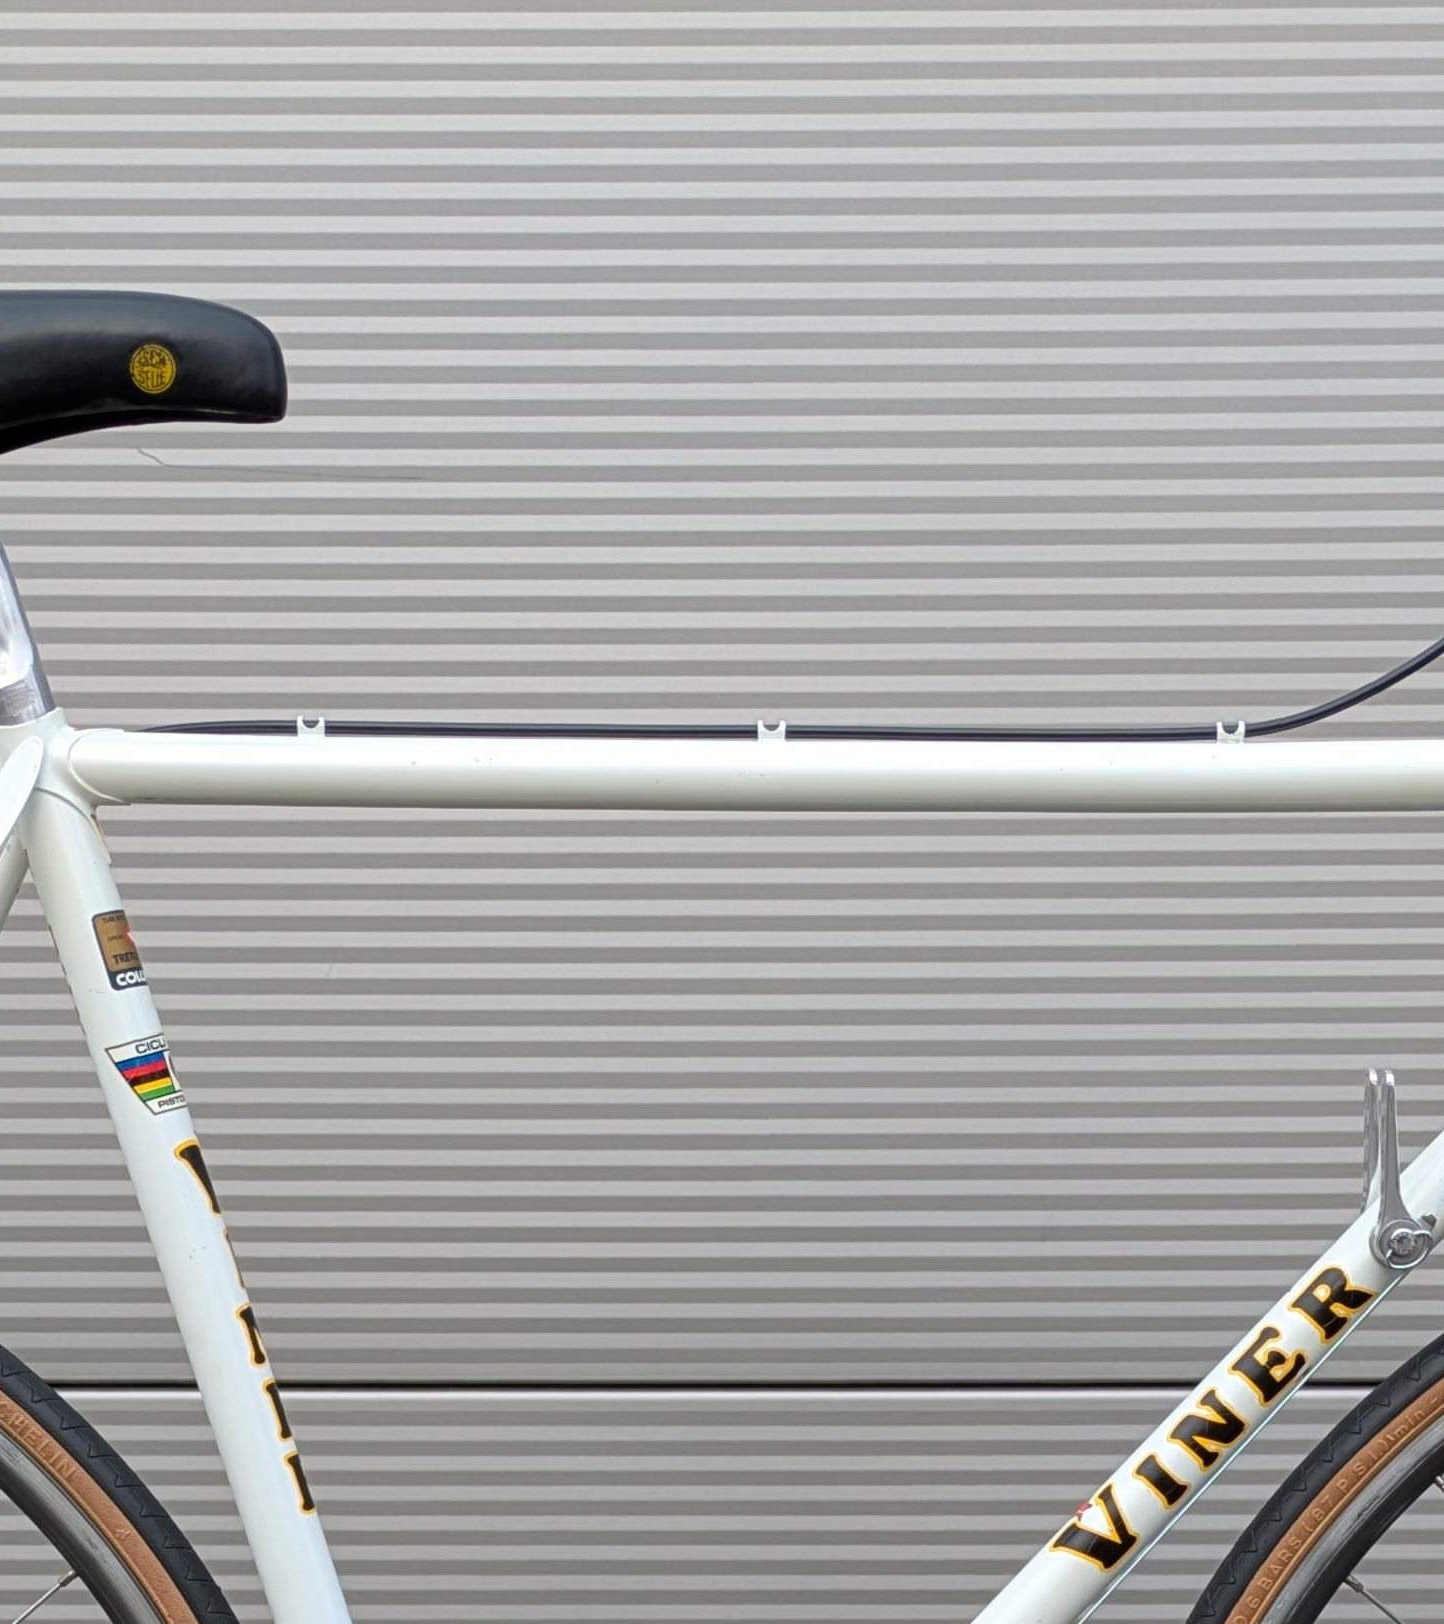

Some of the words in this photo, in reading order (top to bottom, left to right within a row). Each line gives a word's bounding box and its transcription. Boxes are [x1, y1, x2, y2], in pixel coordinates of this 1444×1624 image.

[1050, 1265, 1378, 1574] VINER
[1243, 1593, 1262, 1609] 6
[1256, 1534, 1304, 1590] BARS
